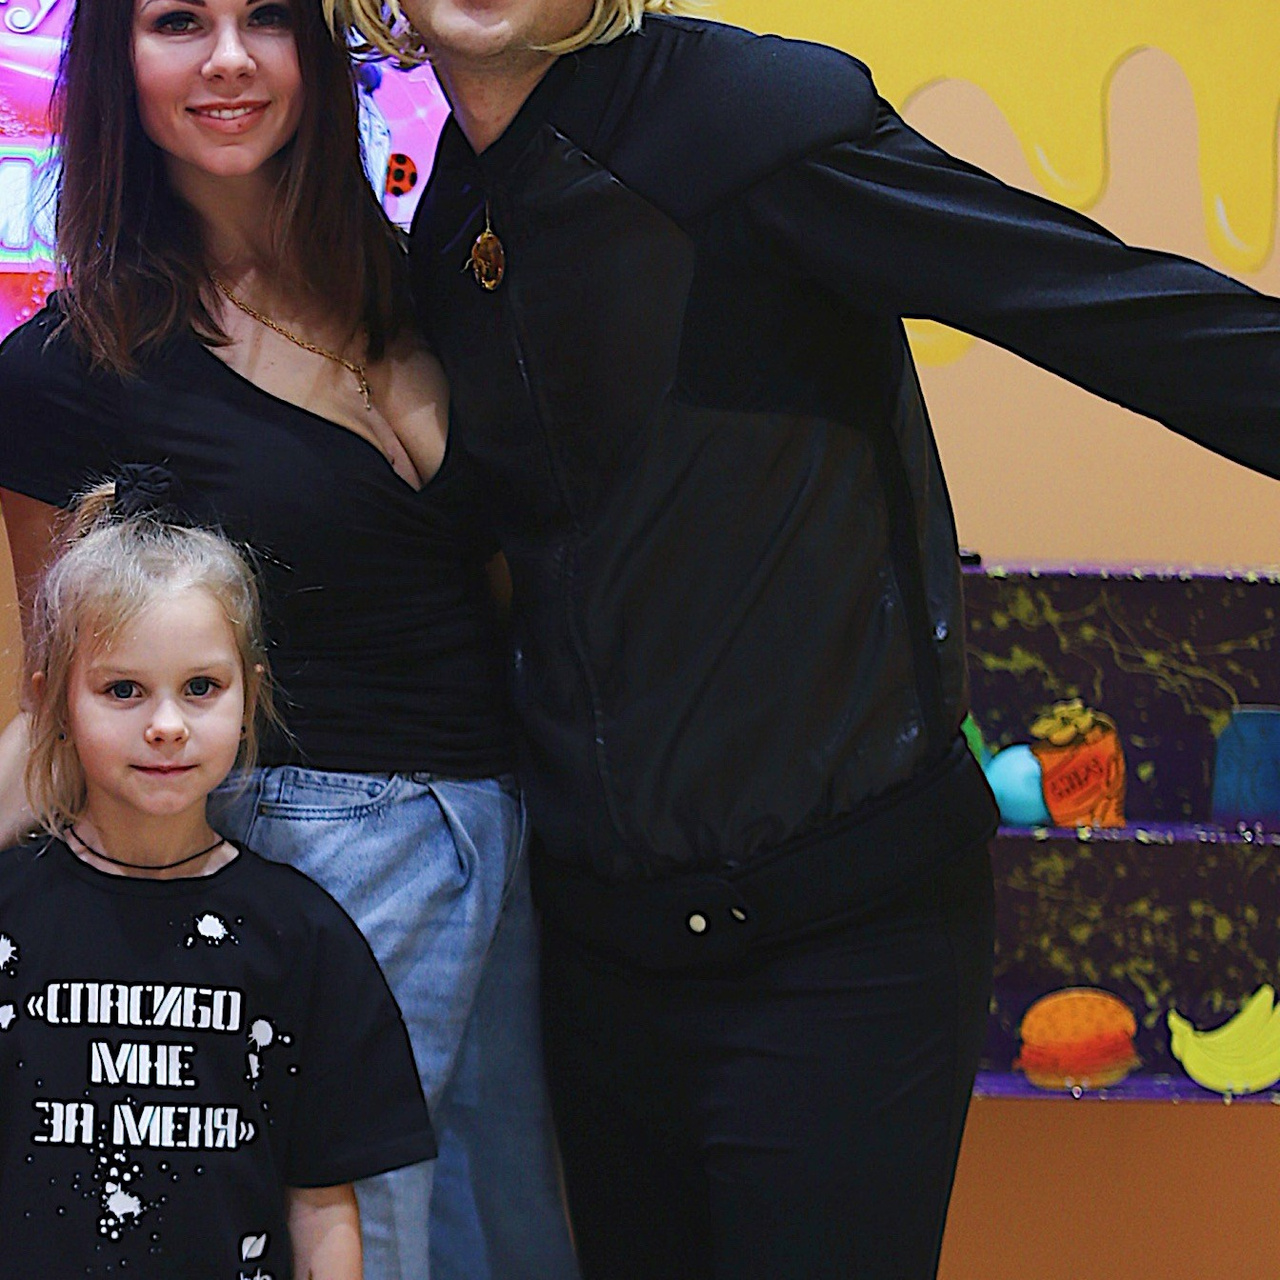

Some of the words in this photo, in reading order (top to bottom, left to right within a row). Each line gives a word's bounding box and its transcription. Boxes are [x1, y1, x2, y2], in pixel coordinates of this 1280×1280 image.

[26, 982, 243, 1031] «СПАСИБО
[91, 1042, 196, 1087] МНЕ
[34, 1101, 94, 1144] ЗА
[113, 1103, 256, 1149] МЕНЯ»
